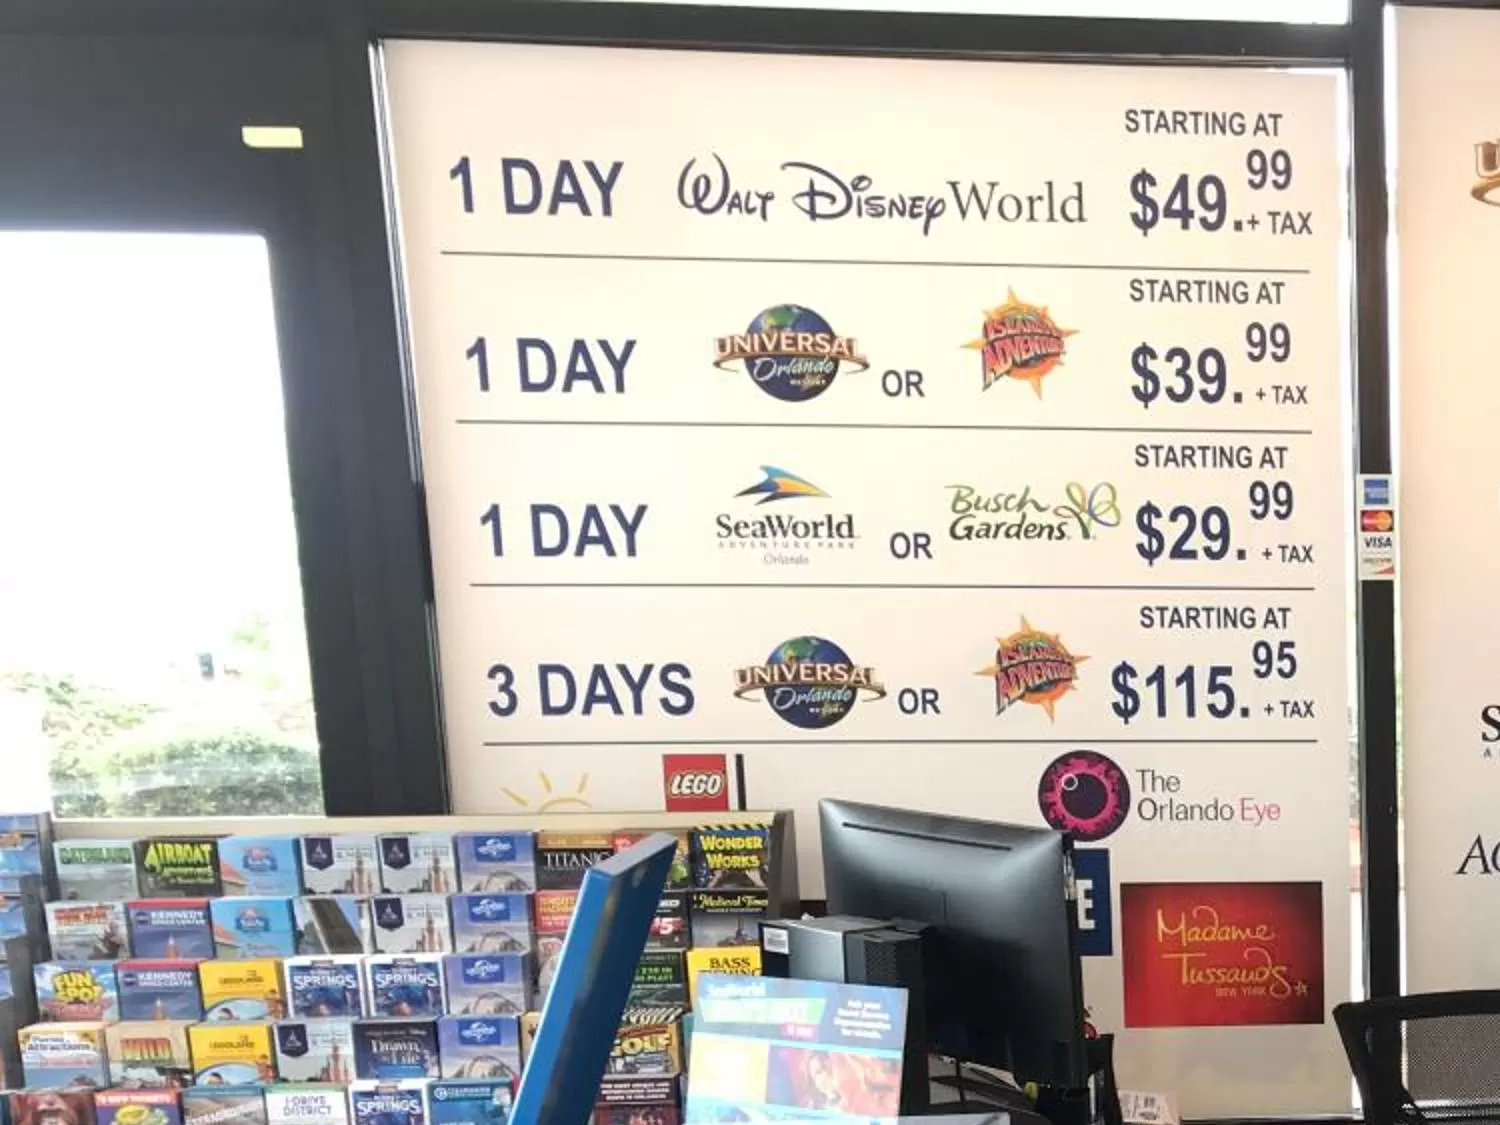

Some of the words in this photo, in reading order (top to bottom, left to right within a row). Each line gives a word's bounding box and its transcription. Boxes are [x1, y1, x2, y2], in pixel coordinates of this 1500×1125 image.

[1125, 109, 1246, 137] STARTING
[1252, 113, 1283, 137] AT
[450, 155, 474, 214] 1
[501, 157, 625, 217] DAY
[678, 152, 775, 221] Walt
[780, 160, 946, 236] Disney
[947, 180, 1088, 223] World
[1267, 211, 1313, 236] TAX
[1129, 279, 1249, 304] STARTING
[1255, 282, 1286, 304] AT
[713, 331, 863, 358] UNIVERSAL
[465, 336, 490, 392] 1
[516, 337, 637, 394] DAY
[753, 355, 835, 382] Orlando
[881, 369, 925, 398] OR
[1272, 386, 1309, 405] TAX
[1135, 444, 1253, 469] STARTING
[1259, 446, 1289, 468] AT
[944, 481, 1055, 515] Busch
[480, 503, 503, 557] 1
[530, 503, 648, 557] DAY
[716, 513, 856, 539] SeaWorld
[949, 511, 1068, 542] Gardens
[890, 532, 933, 559] OR
[1279, 545, 1315, 564] TAX
[1364, 537, 1393, 548] VISA
[1140, 606, 1257, 629] STARTING
[1263, 607, 1292, 628] AT
[734, 662, 884, 689] UNIVERSAL
[487, 663, 518, 717] 3
[538, 663, 696, 717] DAYS
[773, 687, 853, 710] Orlando
[897, 688, 941, 715] OR
[1280, 701, 1315, 718] TAX
[671, 771, 724, 796] LEGO
[1136, 769, 1181, 792] The
[1138, 798, 1235, 822] Orlando
[1241, 797, 1281, 826] Eye
[700, 835, 764, 851] WONDER
[706, 854, 761, 870] WORKS
[1157, 905, 1276, 947] Madame
[709, 956, 751, 969] BASS
[1162, 948, 1292, 998] Tussauds
[54, 971, 94, 989] FUN
[294, 973, 357, 990] SPRINGS
[375, 971, 438, 988] SPRINGS
[357, 1100, 421, 1116] SPRINGS
